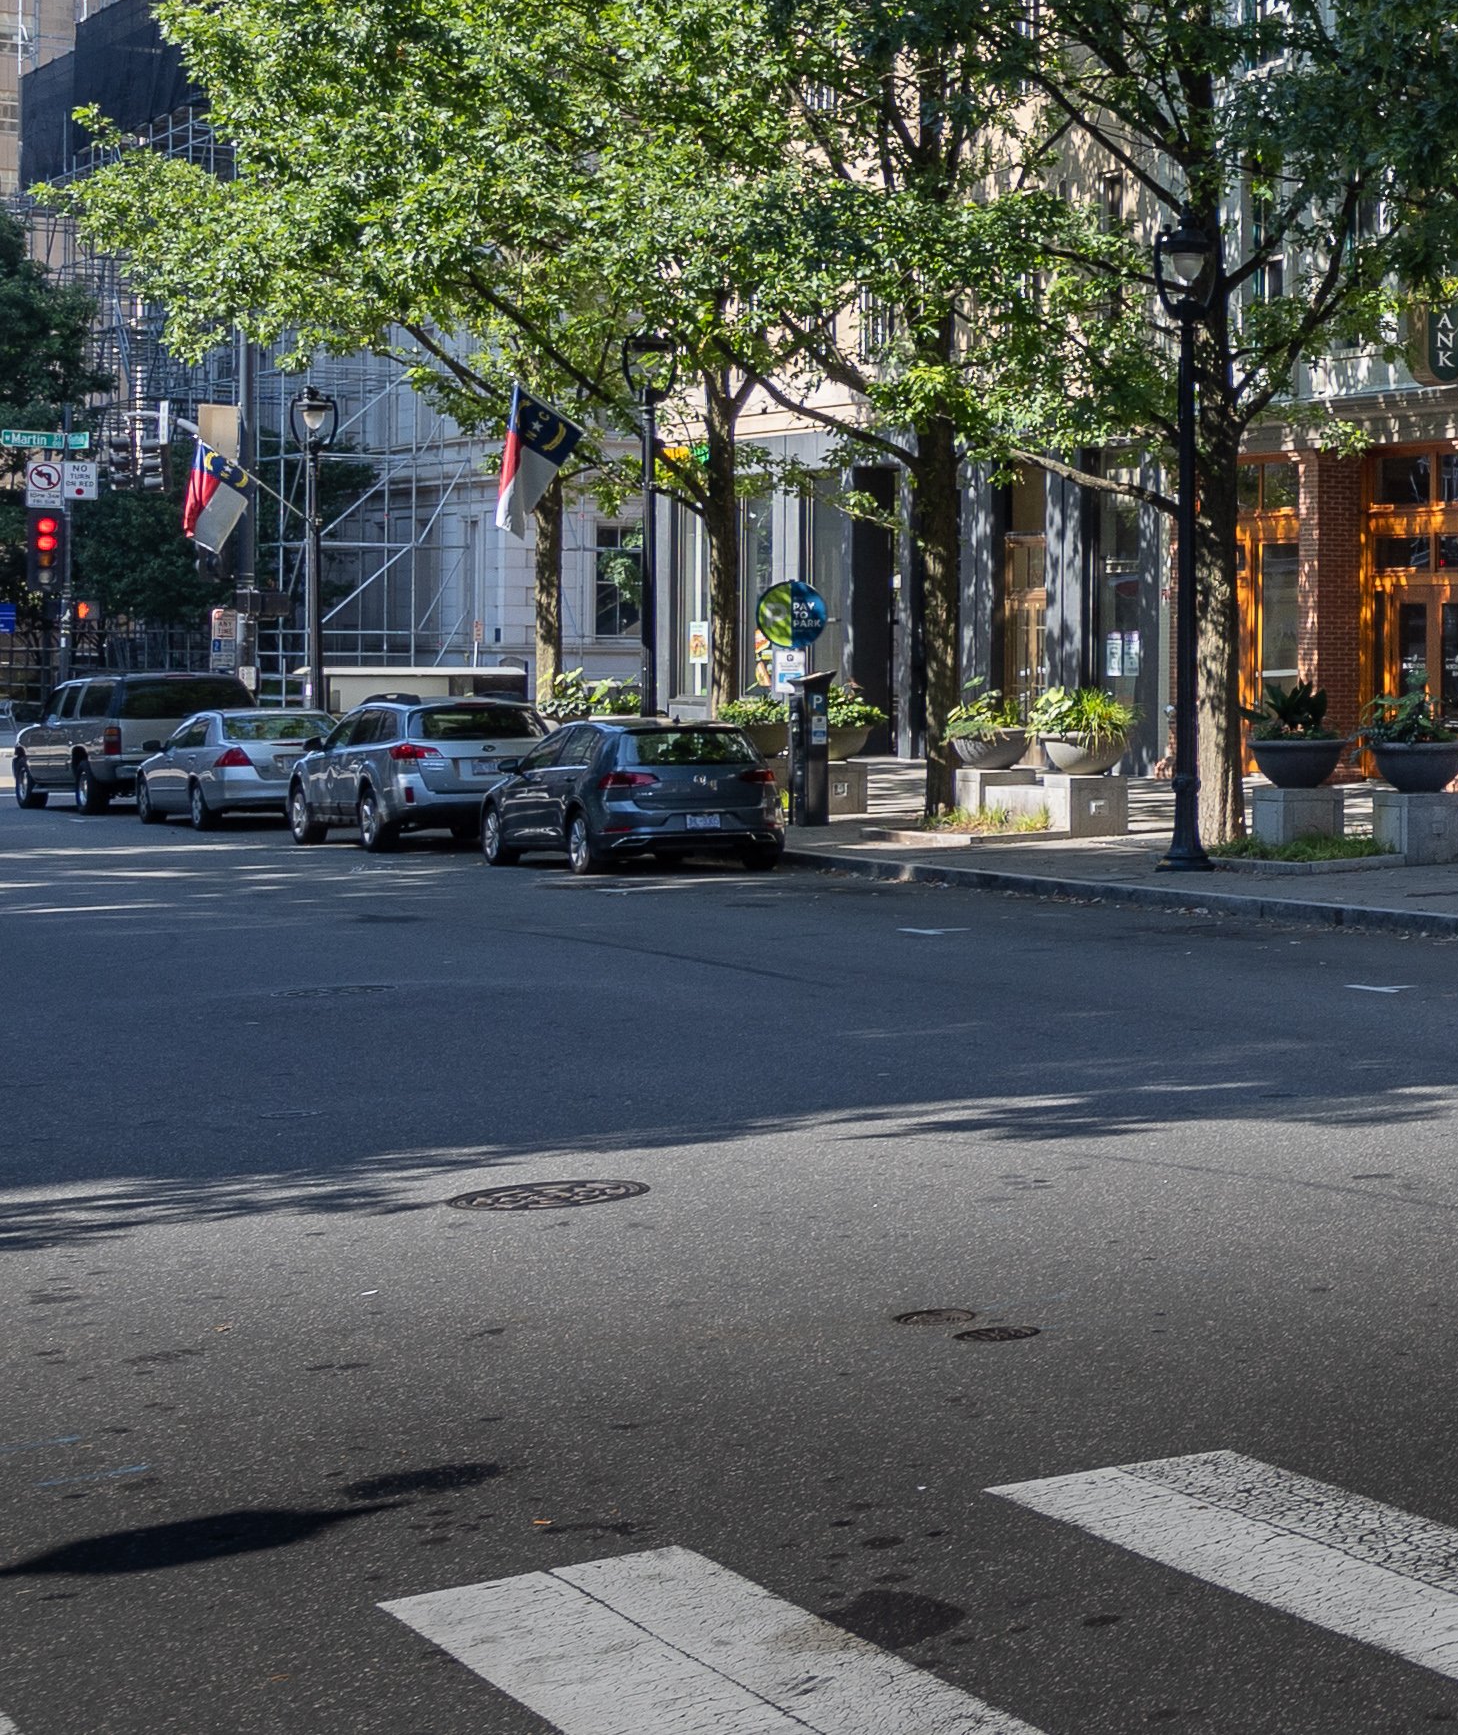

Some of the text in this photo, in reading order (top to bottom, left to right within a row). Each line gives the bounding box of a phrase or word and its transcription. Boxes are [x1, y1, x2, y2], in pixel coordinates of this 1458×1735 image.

[11, 432, 47, 446] Martin
[793, 601, 816, 612] PAY
[794, 611, 809, 619] TO
[793, 619, 821, 628] PARK
